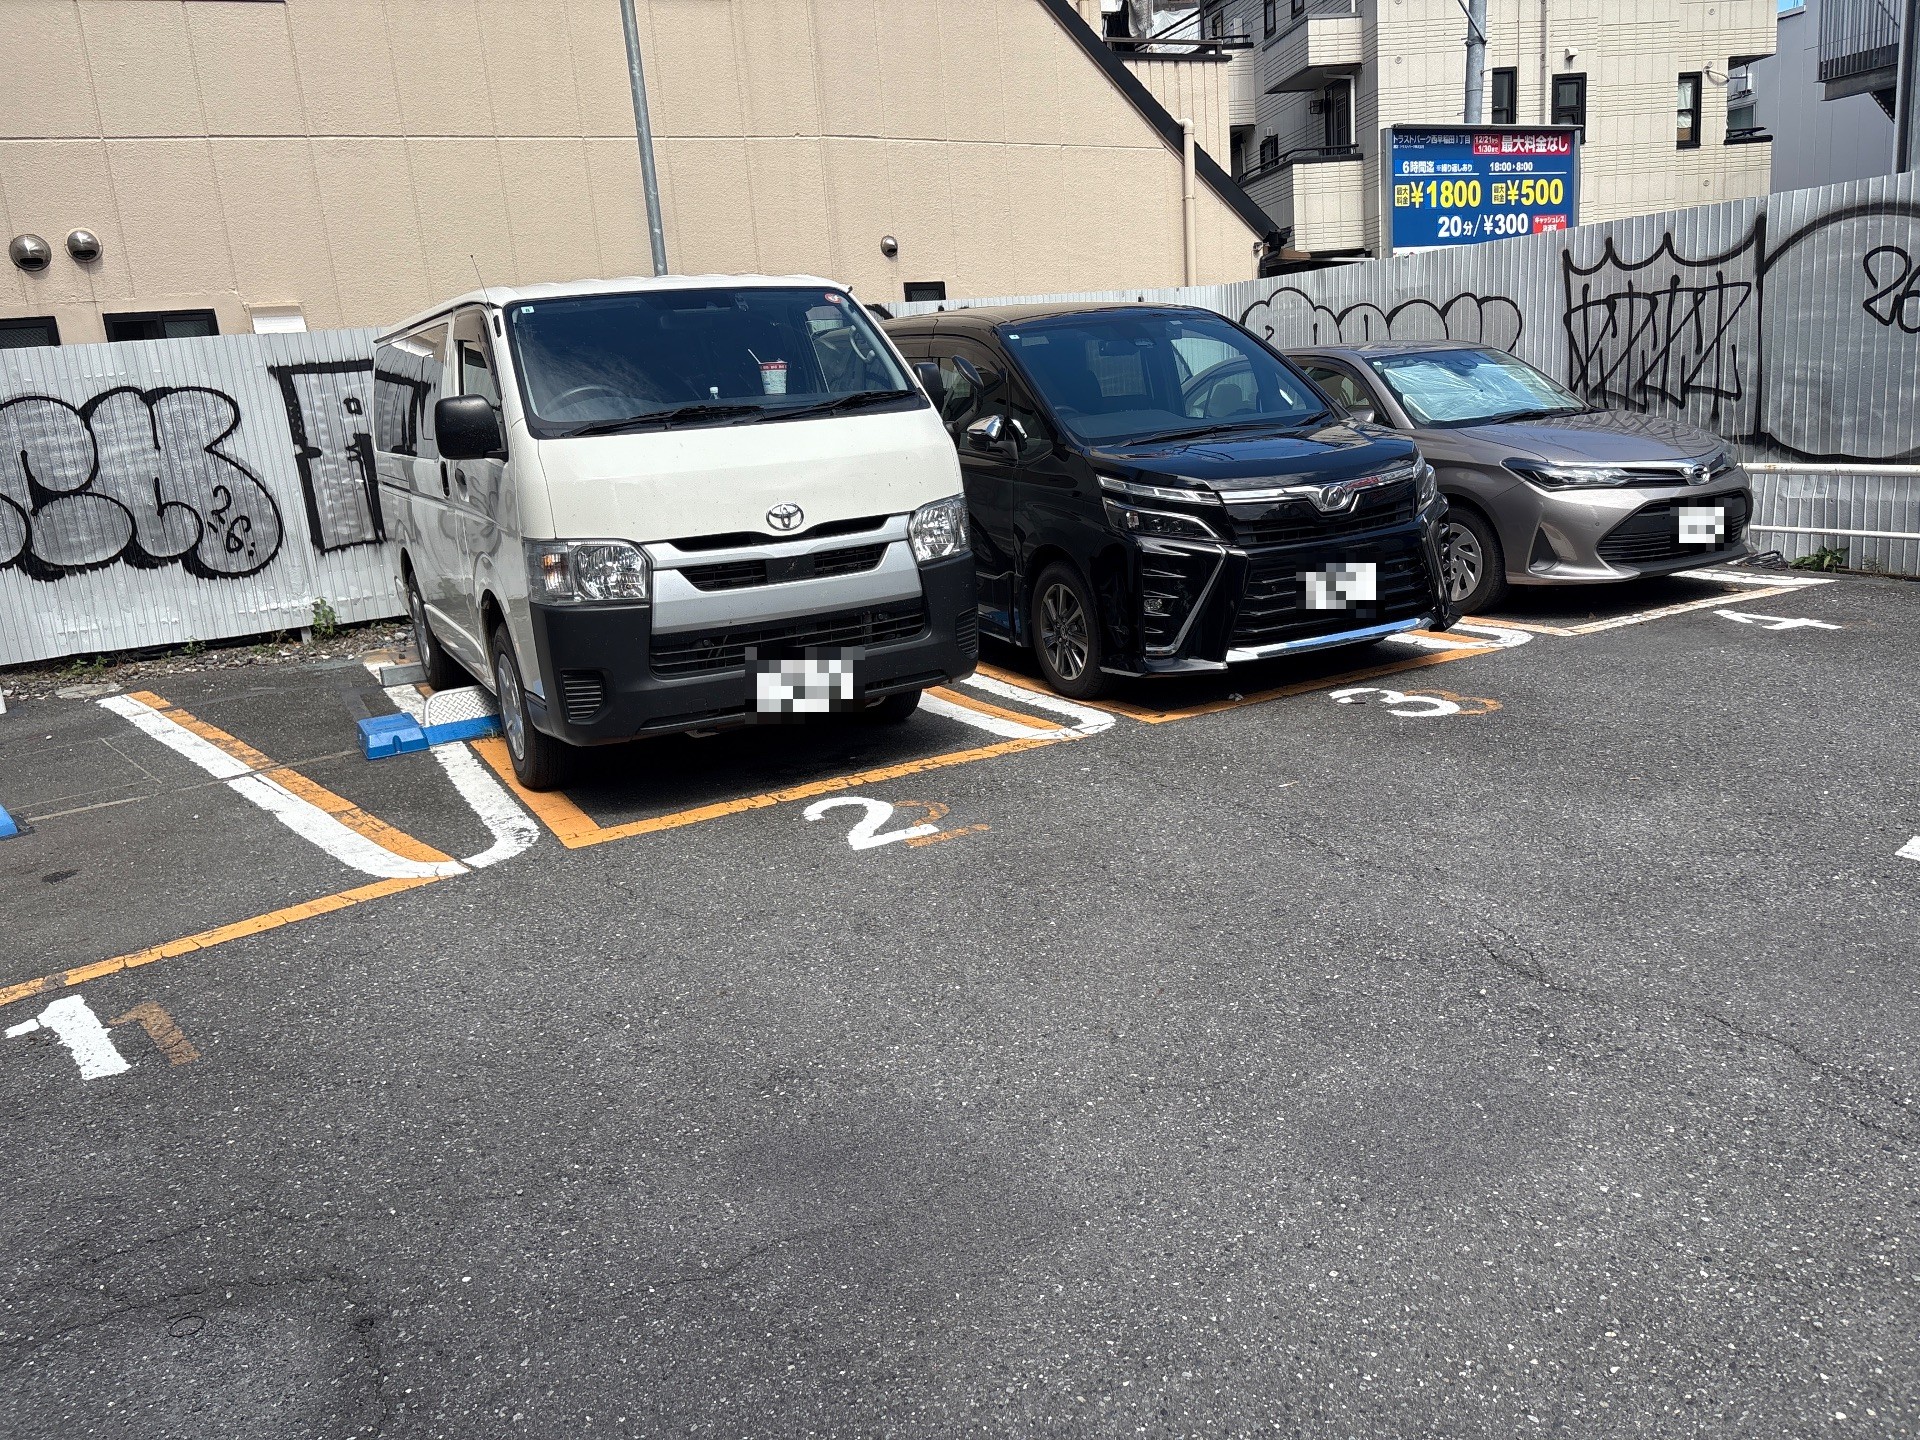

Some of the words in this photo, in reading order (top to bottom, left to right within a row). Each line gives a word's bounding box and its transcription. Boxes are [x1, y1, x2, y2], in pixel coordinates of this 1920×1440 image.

[1501, 134, 1568, 153] 最大料金なし
[1410, 179, 1481, 209] ¥1800
[1507, 178, 1564, 206] ¥500
[1712, 609, 1843, 630] 4
[1329, 687, 1461, 717] 3
[802, 796, 940, 851] 2
[4, 994, 133, 1080] 1
